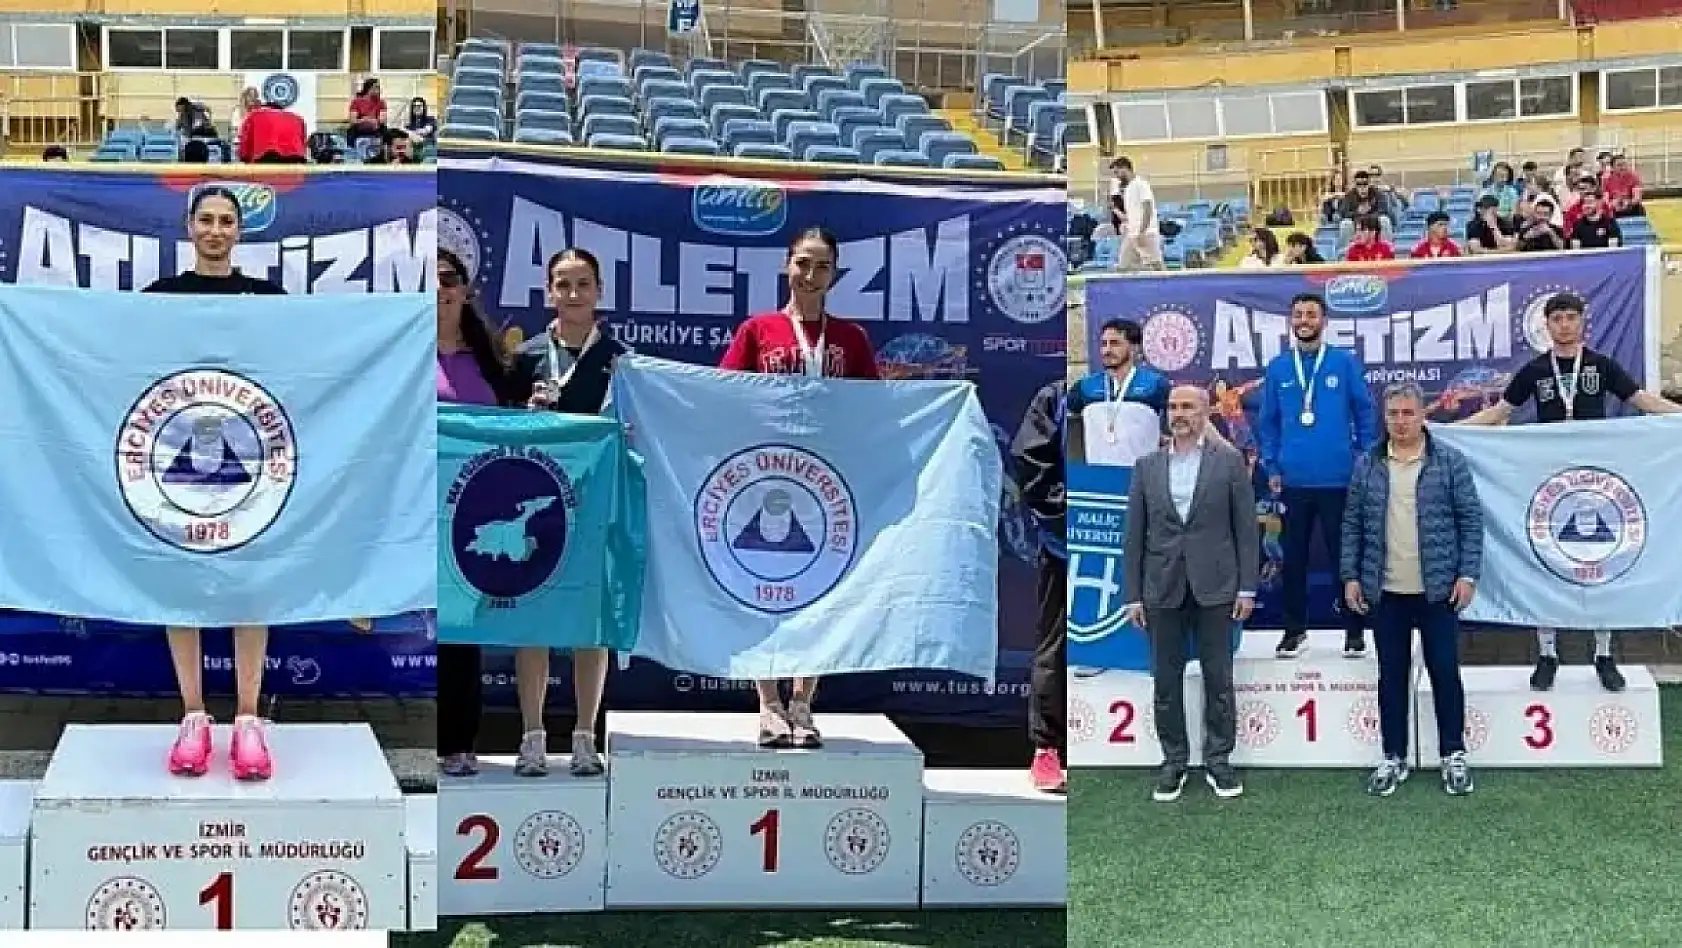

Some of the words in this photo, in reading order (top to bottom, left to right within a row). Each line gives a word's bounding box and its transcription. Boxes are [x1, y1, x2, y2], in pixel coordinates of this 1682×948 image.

[499, 195, 969, 323] ATLETZM
[610, 318, 704, 345] TÜRKİYE
[1211, 282, 1512, 370] ATETİZM
[702, 462, 751, 544] ERCİYES
[756, 451, 849, 554] ÜNİVERSİTESİ
[184, 523, 230, 541] 1978
[754, 583, 795, 602] 1978
[1107, 699, 1136, 743] 2
[1295, 698, 1318, 743] 1
[1524, 704, 1554, 750] 3
[657, 785, 715, 800] GENÇLİK
[720, 787, 738, 799] VE
[743, 787, 779, 799] SPOR
[802, 785, 890, 800] MÜDÜRLÜĞÜ
[752, 768, 790, 783] İZMİR
[198, 819, 246, 837] İZMİR
[453, 814, 500, 880] 2
[750, 809, 780, 873] 1
[87, 843, 157, 864] GENÇLİK
[162, 846, 184, 859] VE
[190, 845, 232, 859] SPOR
[238, 843, 252, 859] İL
[260, 840, 366, 860] MÜDÜRLÜĞÜ
[198, 871, 235, 931] 1
